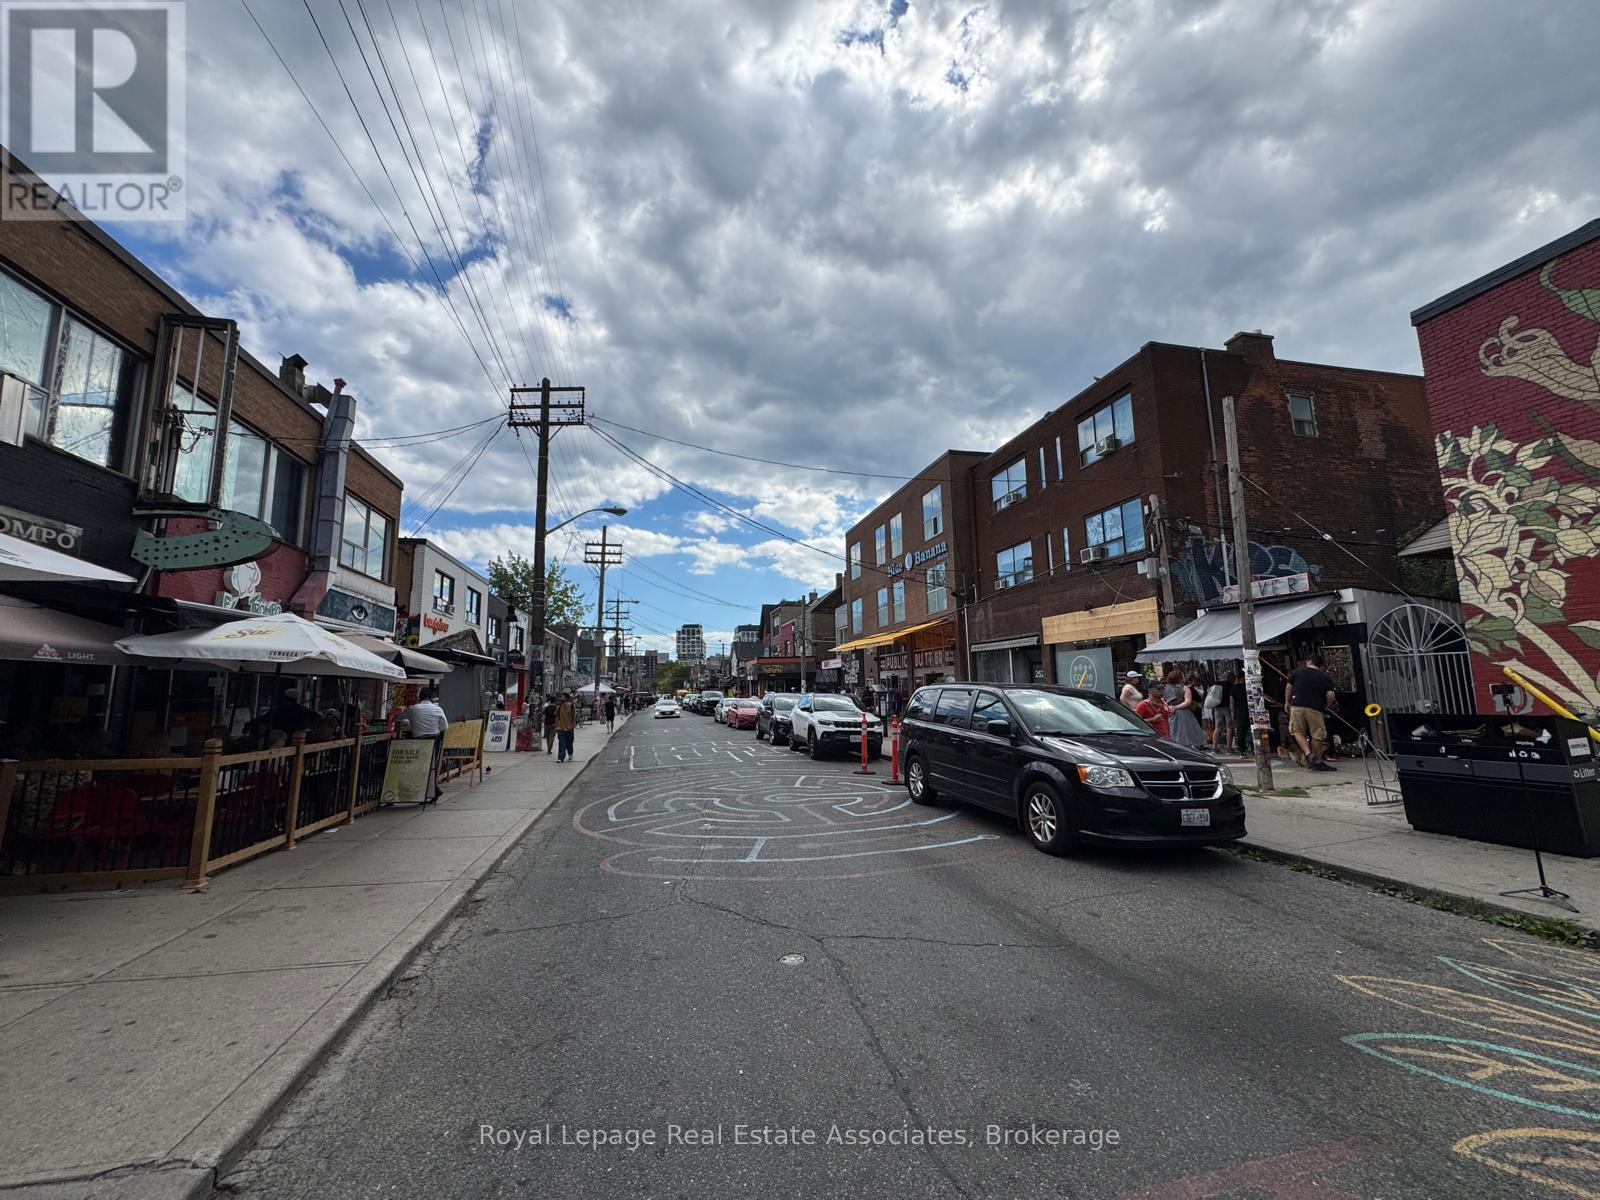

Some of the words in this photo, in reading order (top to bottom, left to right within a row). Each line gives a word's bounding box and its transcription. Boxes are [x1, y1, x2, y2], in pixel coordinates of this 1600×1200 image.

[914, 541, 948, 566] Banana
[1224, 577, 1298, 601] SVER
[67, 651, 95, 660] LIGHT
[269, 650, 298, 658] CERVEZA
[886, 654, 908, 670] PUBLIC
[1579, 767, 1596, 778] Litter
